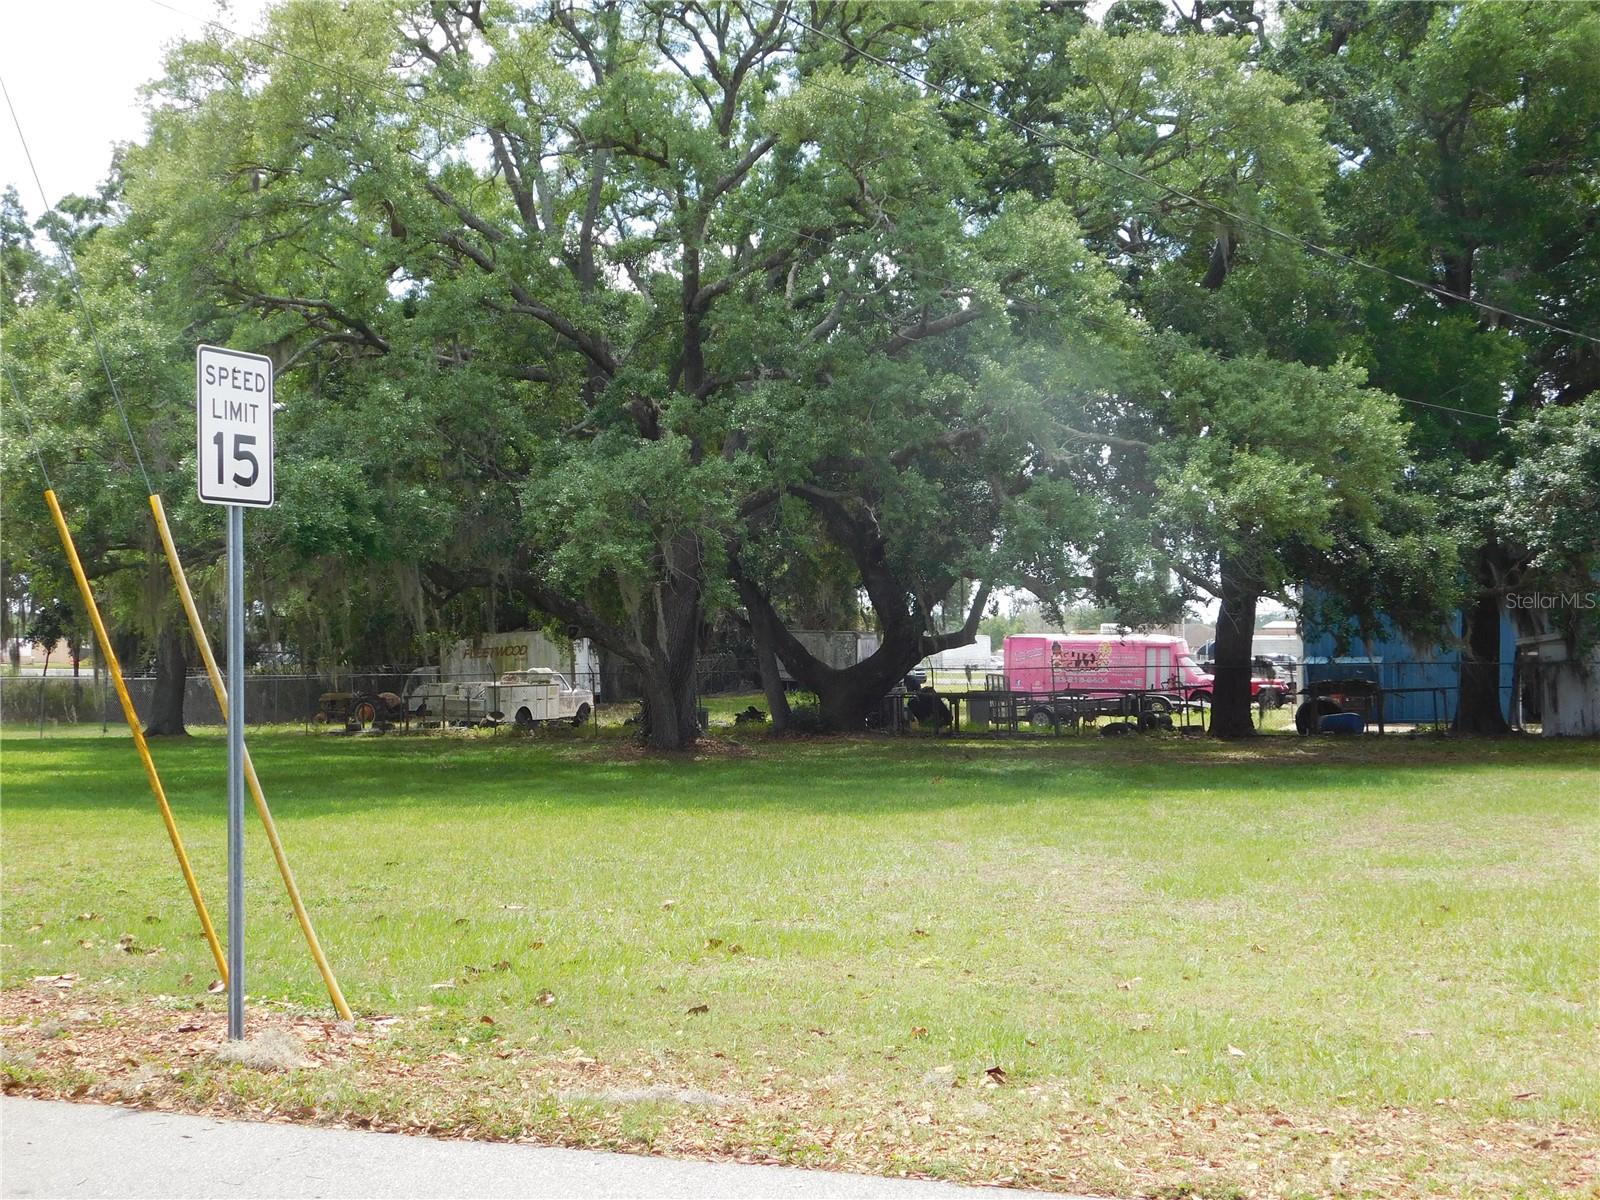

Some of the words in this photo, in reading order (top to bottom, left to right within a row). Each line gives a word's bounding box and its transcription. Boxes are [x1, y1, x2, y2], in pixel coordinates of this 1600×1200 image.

[205, 364, 266, 393] SPEED
[212, 398, 259, 424] LIMIT
[213, 431, 259, 488] 15
